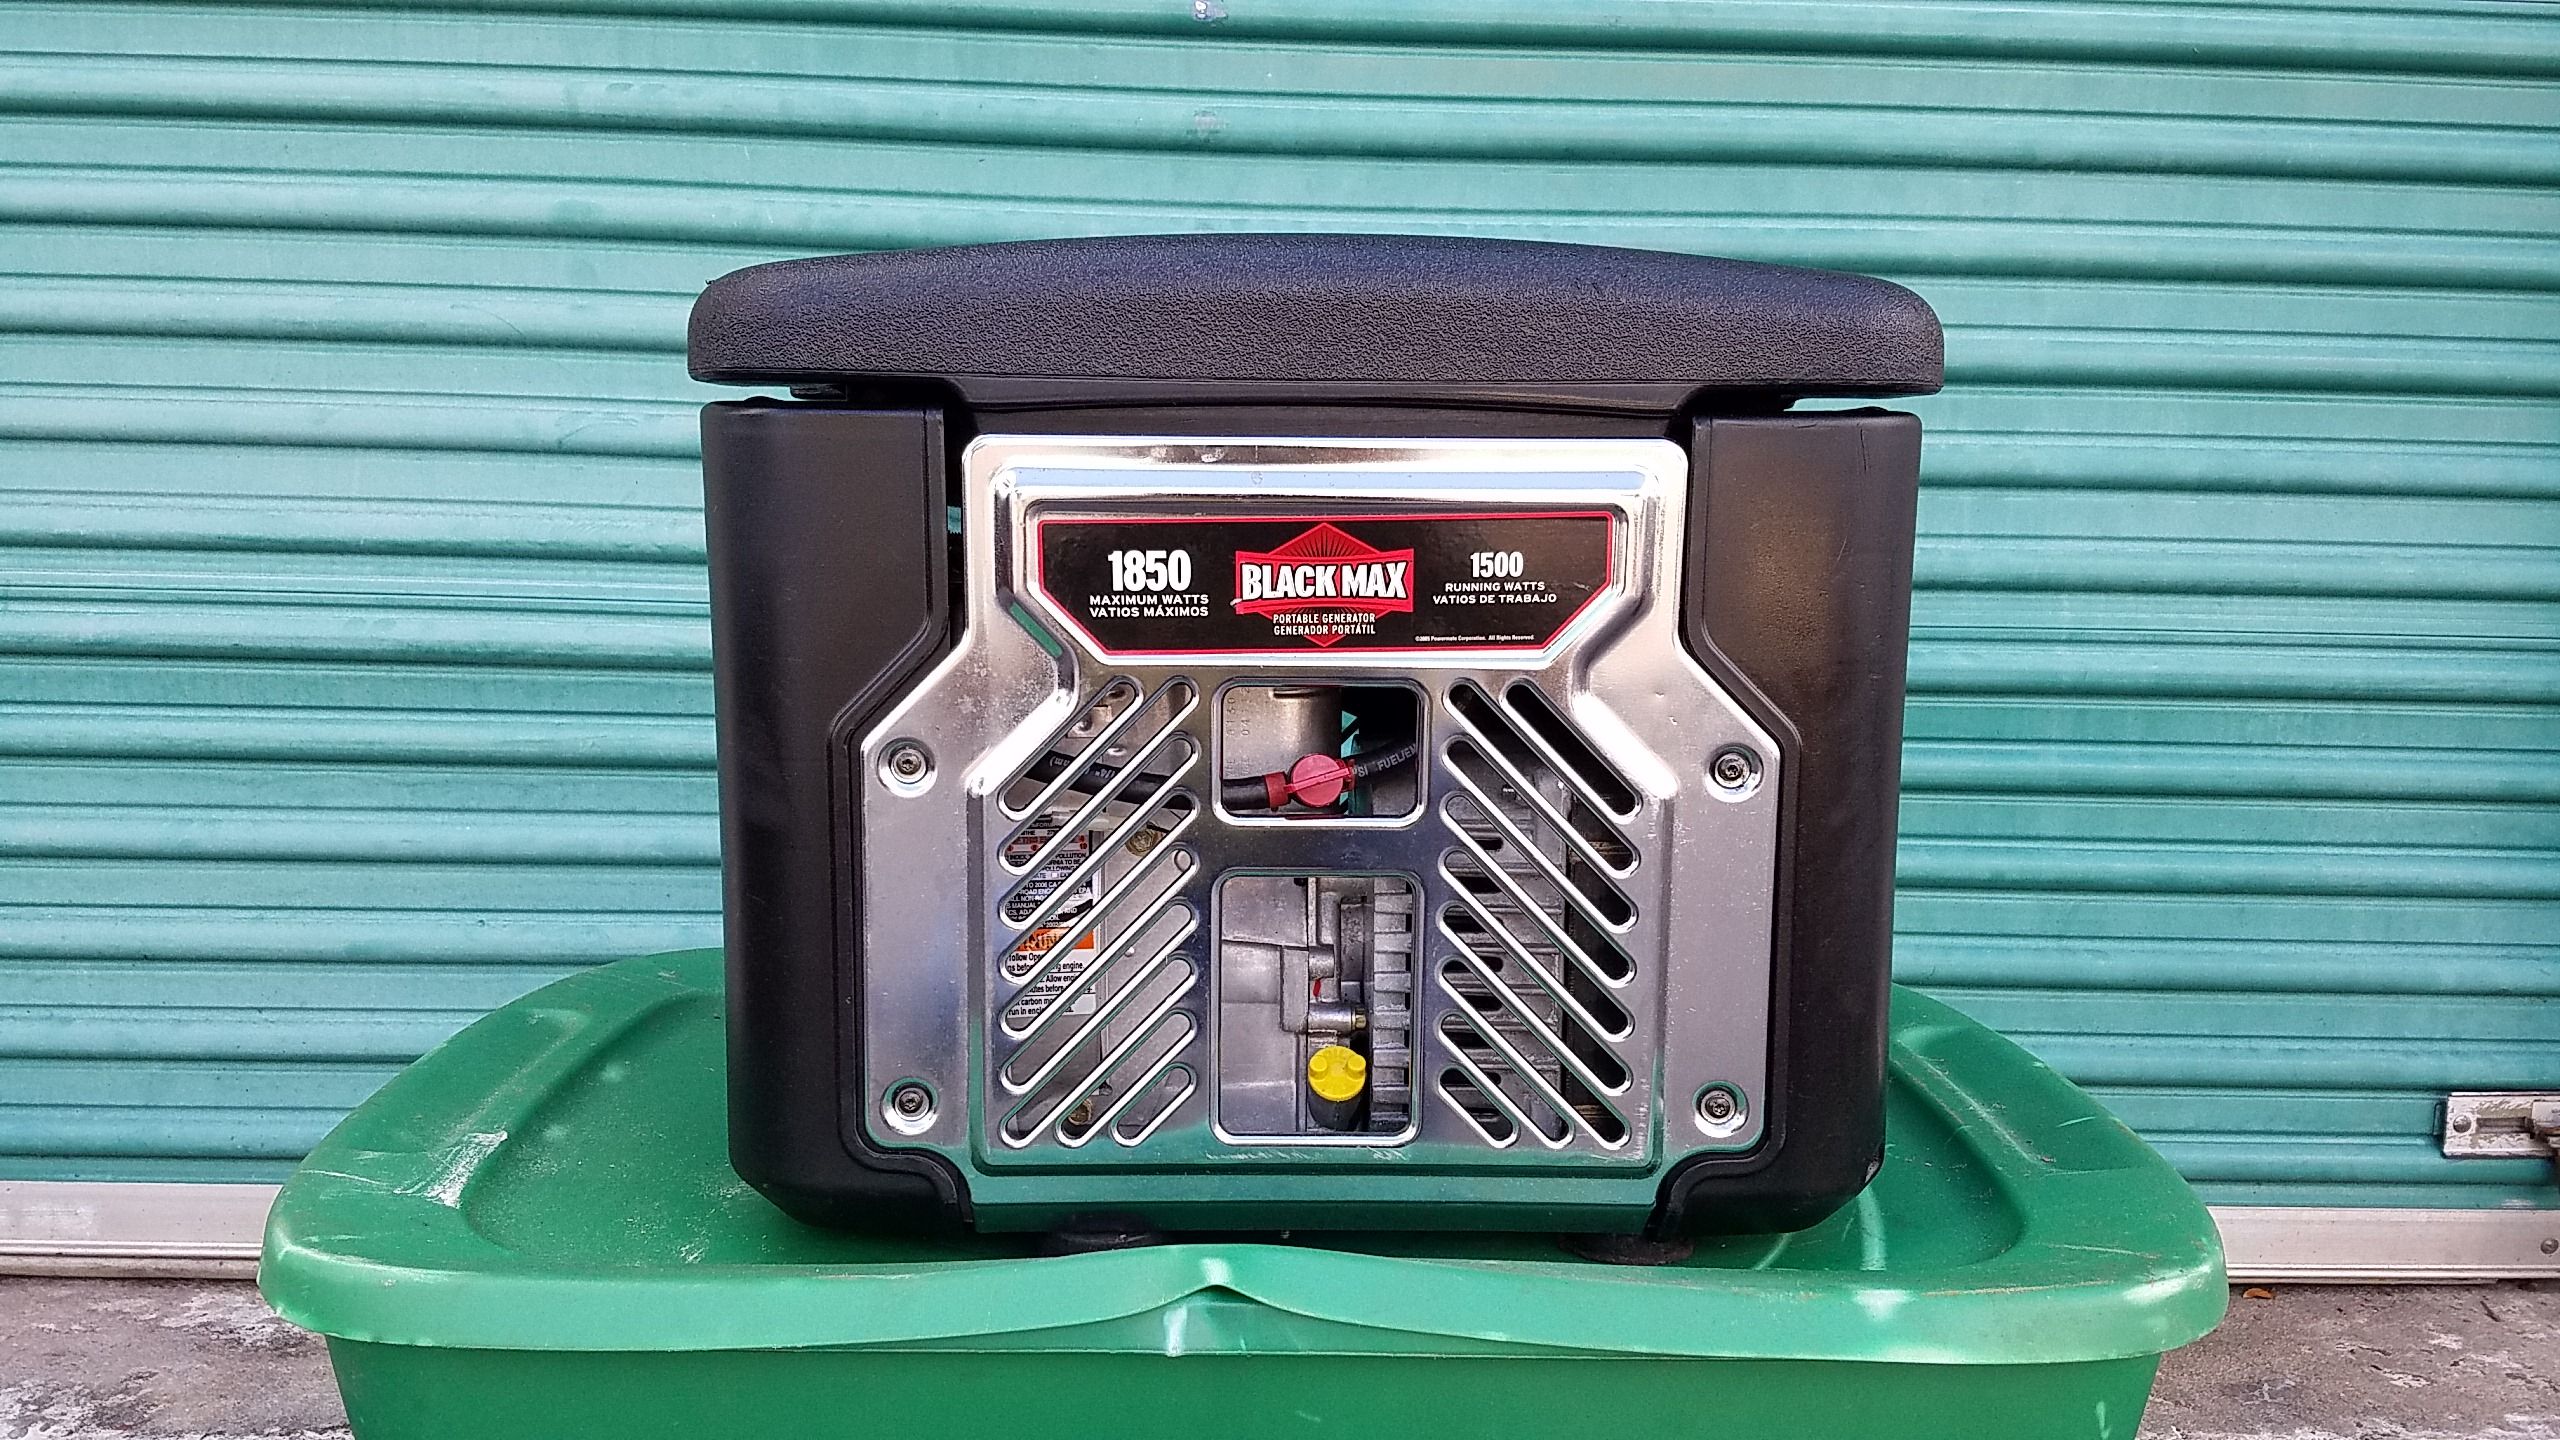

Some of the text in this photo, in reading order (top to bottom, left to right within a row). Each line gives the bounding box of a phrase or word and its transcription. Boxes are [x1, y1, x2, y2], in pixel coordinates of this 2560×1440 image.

[1107, 549, 1192, 592] 1850
[1469, 551, 1524, 578] 1500
[1241, 560, 1408, 601] BLACK MAX
[1445, 581, 1546, 592] RUNNING WATTS
[1089, 594, 1209, 605] MAXIMUM WATTS
[1432, 593, 1557, 604] VATIOS DE TRABAJO
[1089, 604, 1209, 618] VATIOS MÁXIMOS
[1272, 612, 1376, 624] PORTABLE GENERATOR
[1273, 622, 1377, 636] GENERADOR PORTÁTIL
[1495, 634, 1511, 642] Rights
